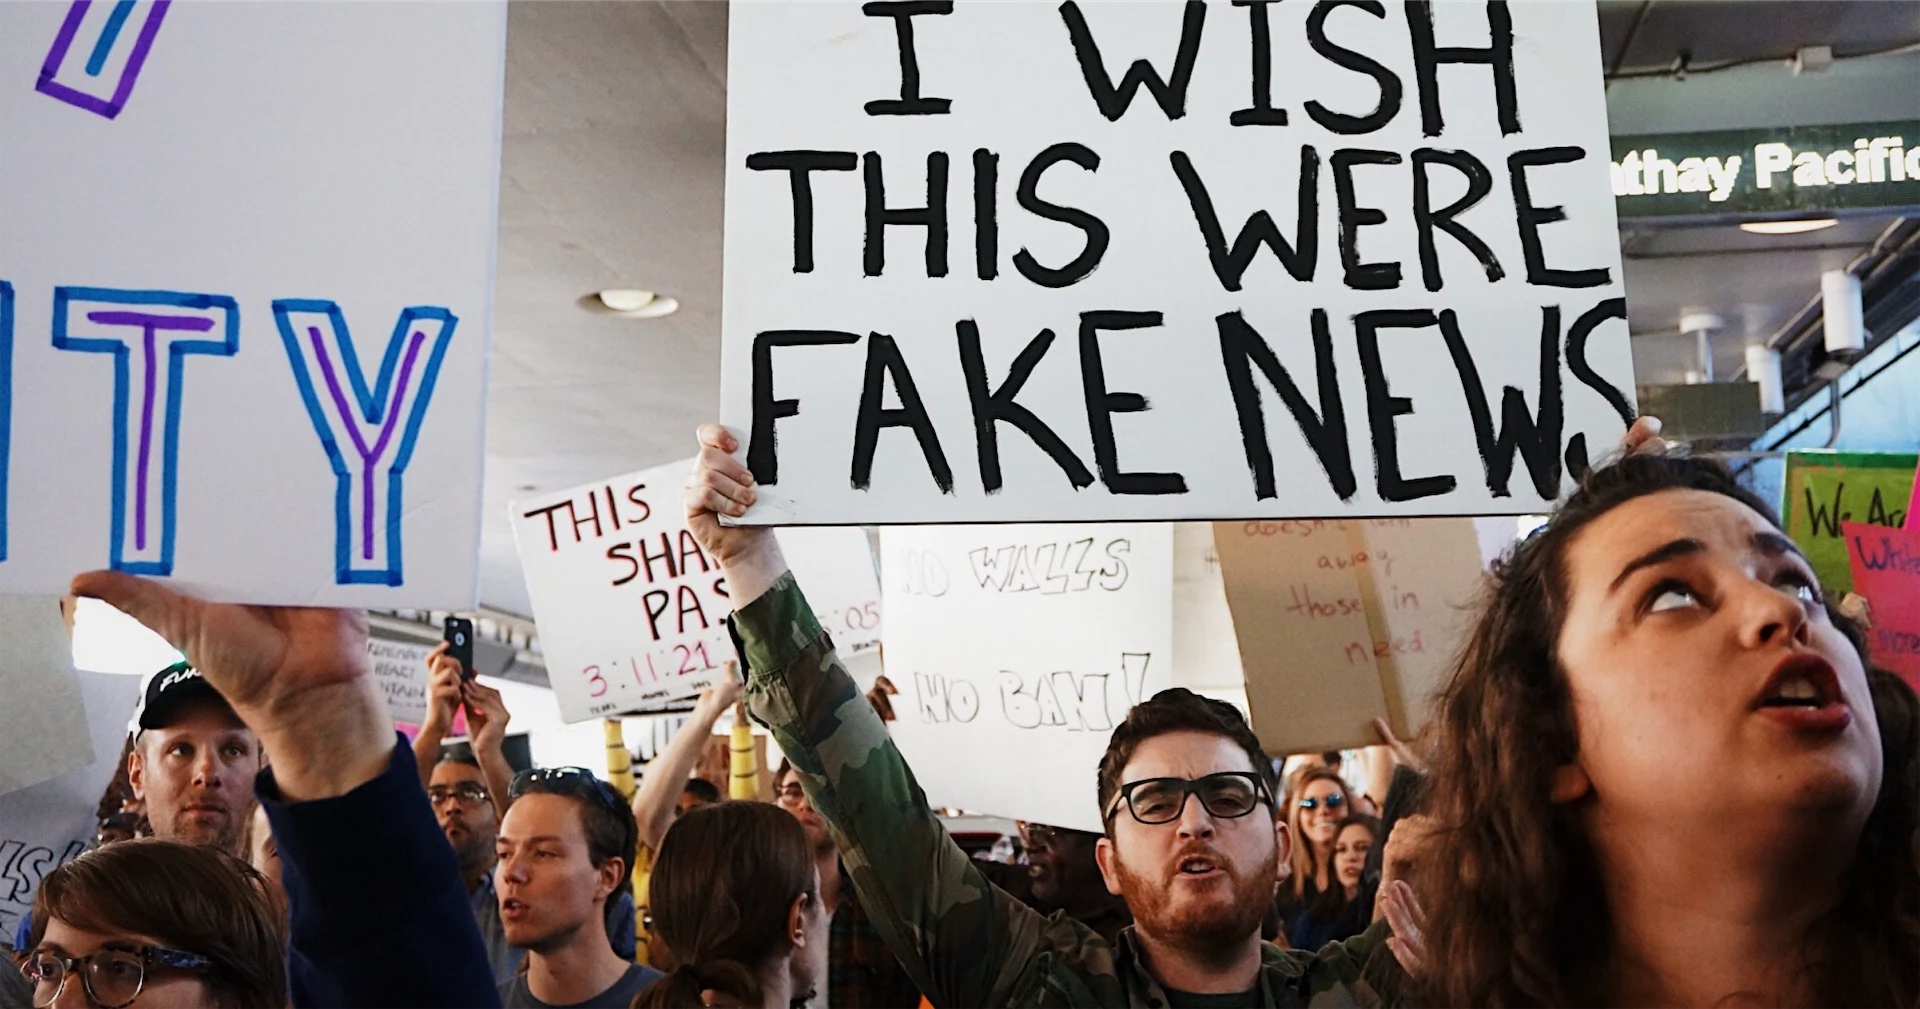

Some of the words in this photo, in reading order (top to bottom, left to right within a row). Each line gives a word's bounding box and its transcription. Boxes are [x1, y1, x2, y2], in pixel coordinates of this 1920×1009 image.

[862, 0, 953, 115] I
[1059, 0, 1522, 137] WISH
[746, 142, 1110, 288] THIS
[1170, 145, 1612, 291] WERE
[747, 310, 1189, 495] FAKE
[1215, 297, 1638, 501] NEWS
[0, 280, 459, 586] TY
[524, 484, 651, 551] THIS
[969, 537, 1131, 595] WALLS
[1285, 583, 1362, 619] those
[1391, 584, 1420, 610] in
[1345, 630, 1423, 666] need
[914, 672, 980, 724] NO
